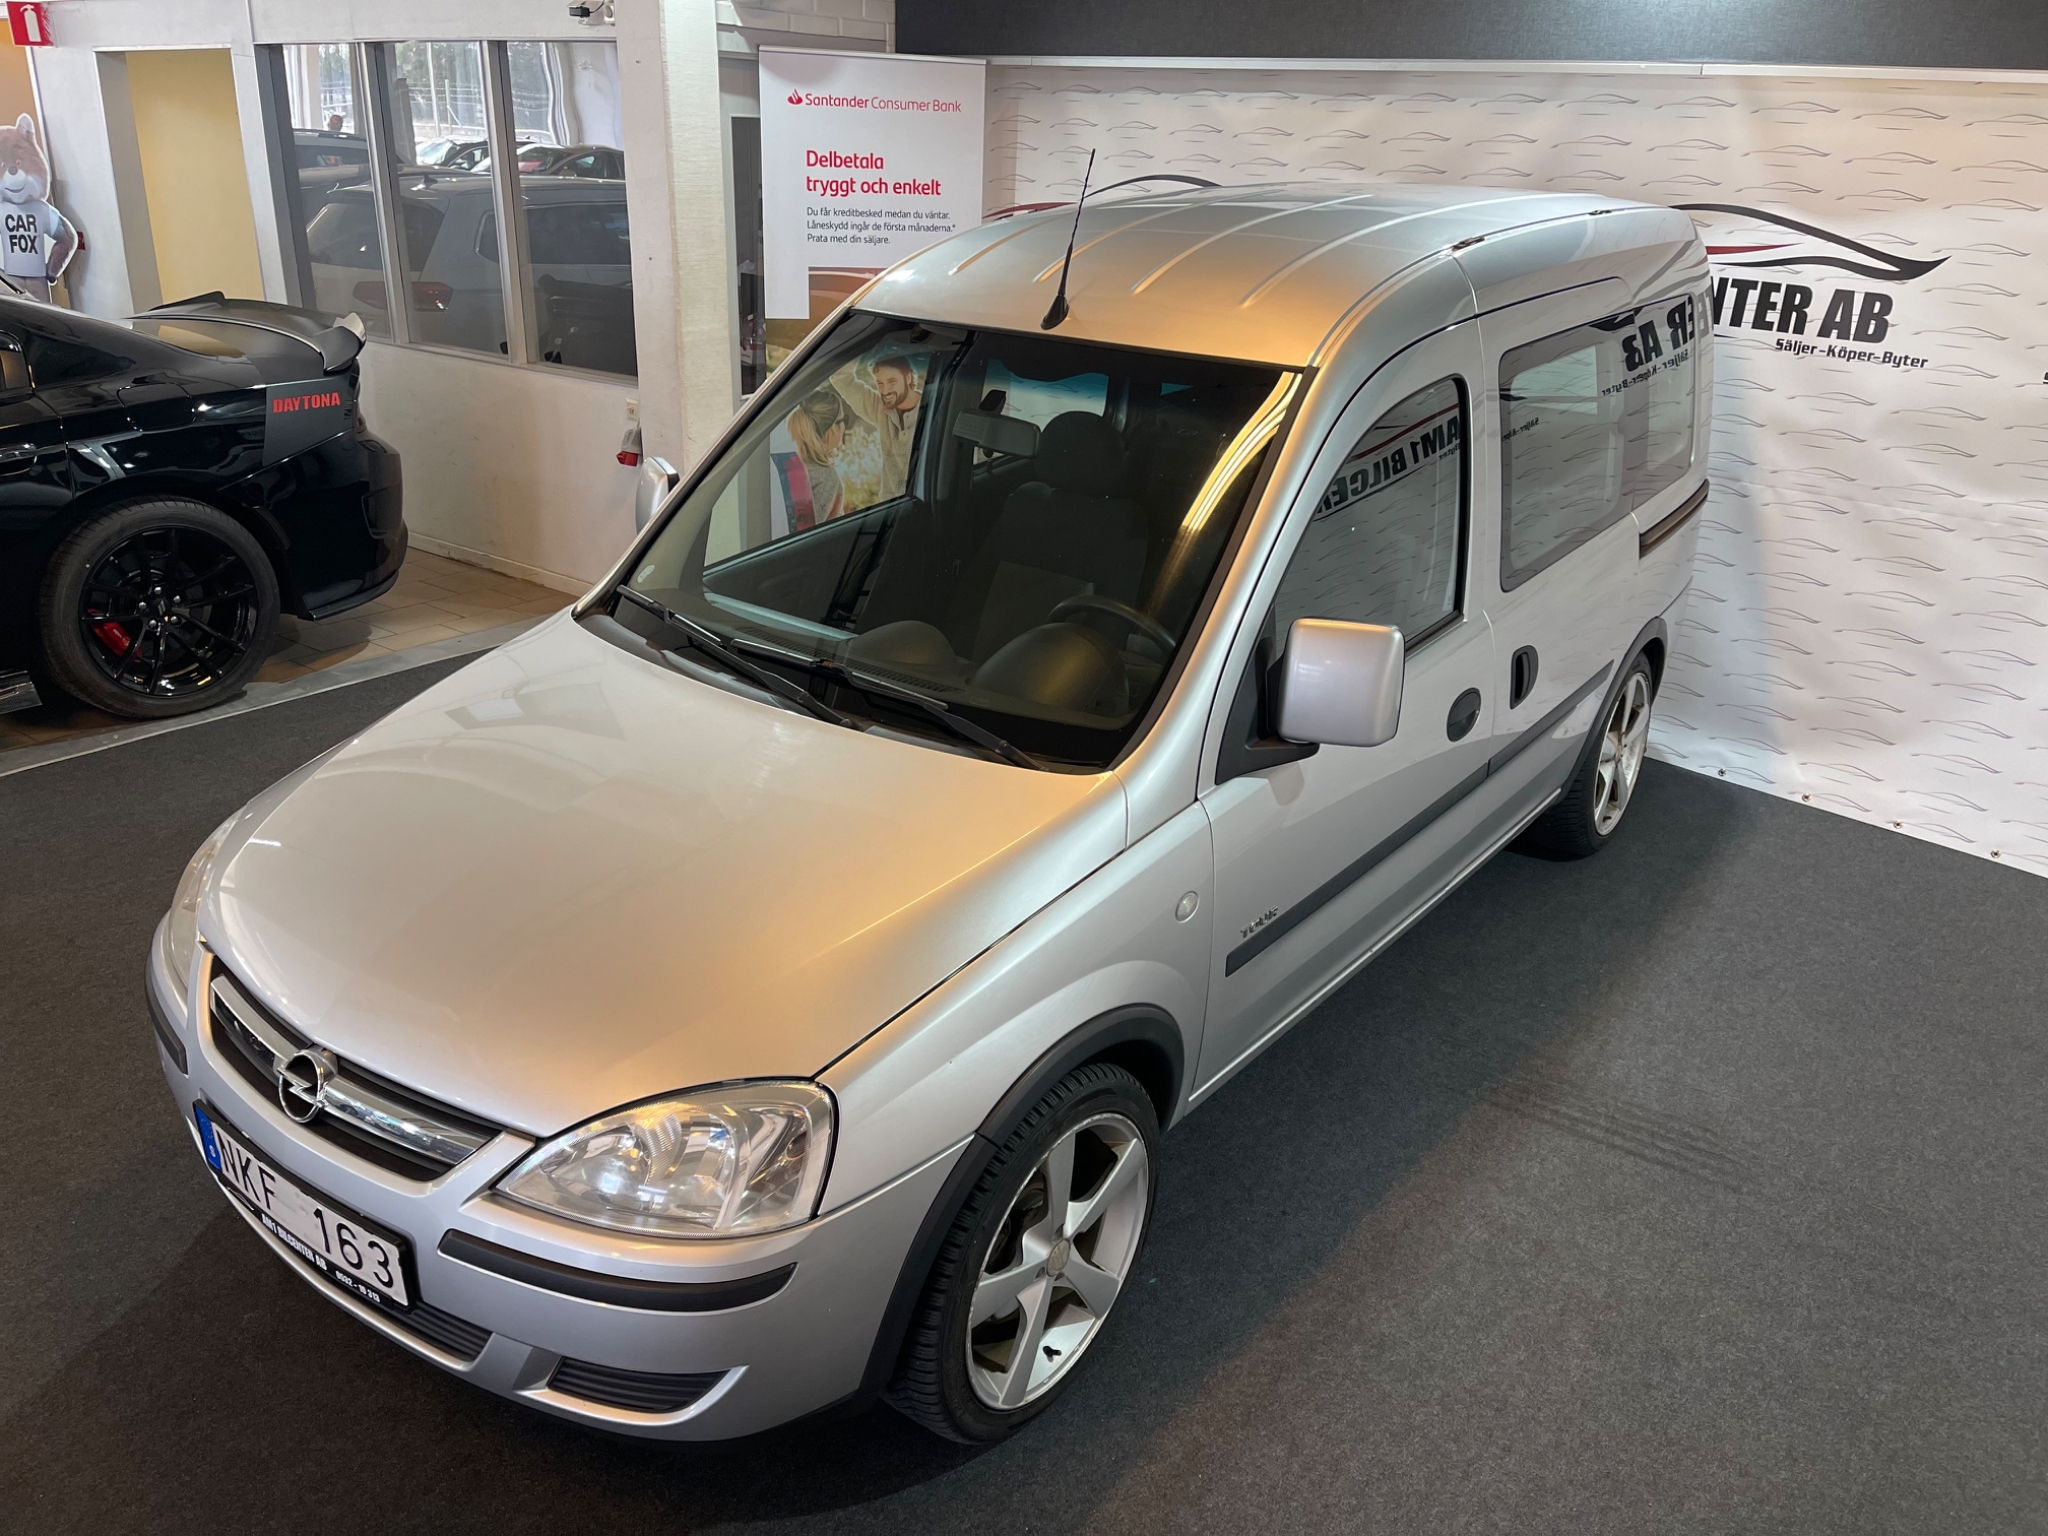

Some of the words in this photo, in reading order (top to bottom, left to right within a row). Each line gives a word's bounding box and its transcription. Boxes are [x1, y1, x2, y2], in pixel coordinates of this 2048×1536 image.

[805, 93, 869, 108] Santander
[871, 96, 931, 112] Consumer
[932, 99, 962, 113] Bank
[806, 149, 884, 170] Delbetala
[806, 175, 856, 197] tryggt
[860, 177, 889, 194] och
[892, 178, 942, 196] enkelt
[4, 214, 38, 233] CAR
[806, 206, 819, 217] Du
[820, 206, 831, 217] får
[833, 207, 883, 218] kreditbesked
[884, 209, 912, 219] medan
[912, 209, 924, 220] du
[924, 210, 951, 220] väntar.
[806, 219, 849, 232] Låneskydd
[850, 221, 870, 233] ingår
[871, 221, 882, 232] de
[883, 222, 906, 232] första
[8, 234, 39, 255] FOX
[807, 233, 828, 243] Prata
[829, 234, 848, 244] med
[849, 234, 862, 244] din
[863, 235, 891, 246] säljare.
[1817, 288, 1894, 344] AB
[273, 392, 341, 413] DAYTONA
[215, 1129, 275, 1210] NKF
[313, 1207, 394, 1289] 163
